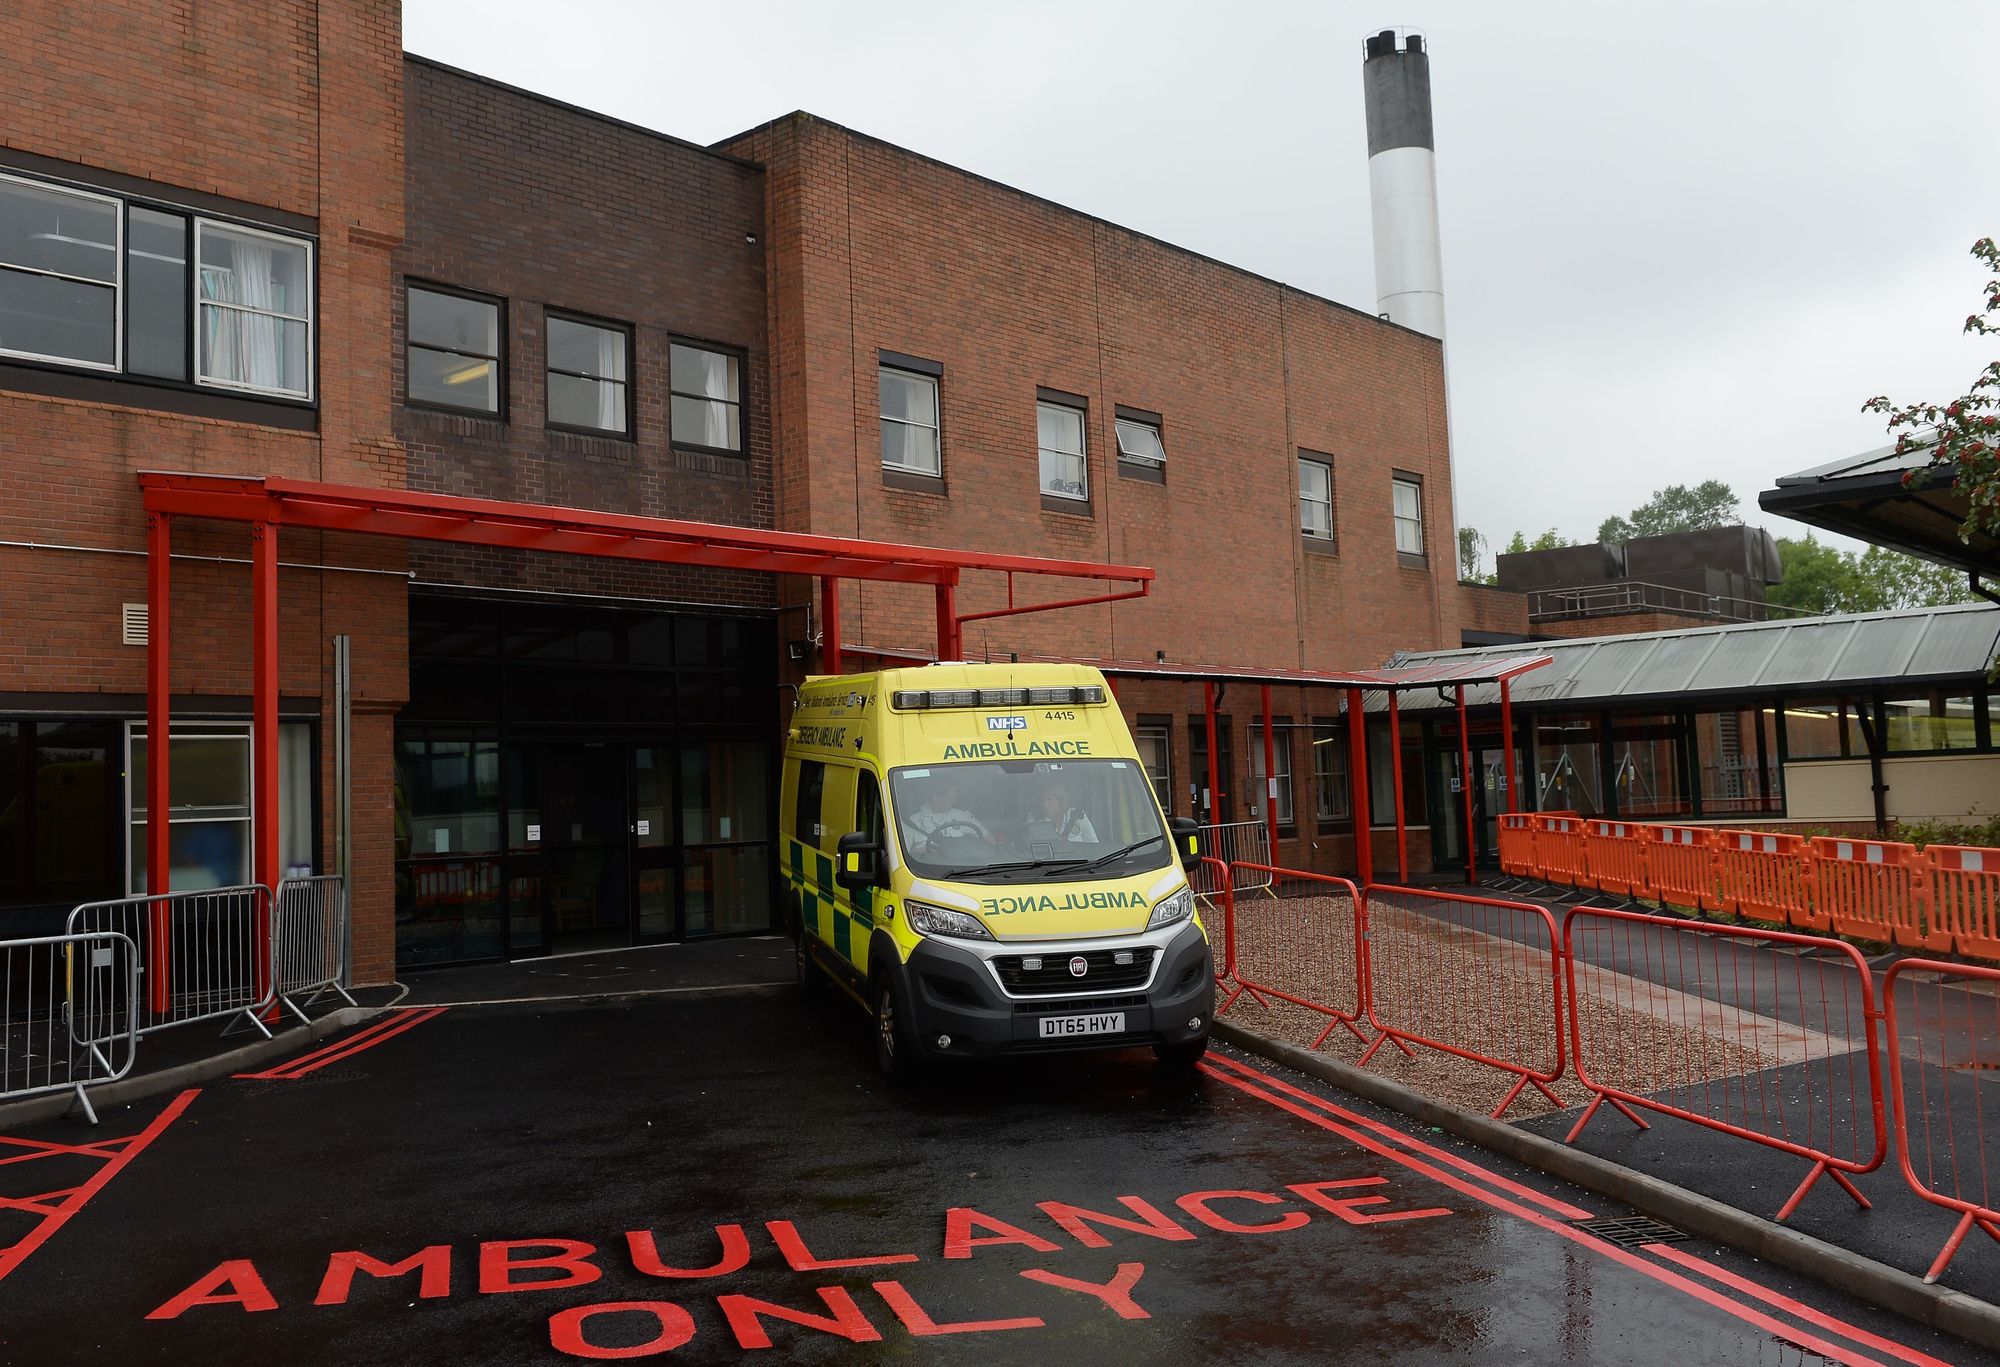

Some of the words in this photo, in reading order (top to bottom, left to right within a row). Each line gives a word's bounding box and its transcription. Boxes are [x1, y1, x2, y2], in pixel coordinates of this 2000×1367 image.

[989, 717, 1025, 729] NHS
[1045, 711, 1075, 721] 4415
[943, 741, 1092, 760] AMBULANCE
[1073, 962, 1084, 972] FIAT
[1045, 1018, 1086, 1035] DT65
[1089, 1015, 1119, 1032] HVY
[145, 1177, 1452, 1320] AMBULANCE
[549, 1262, 1150, 1360] ONLY
